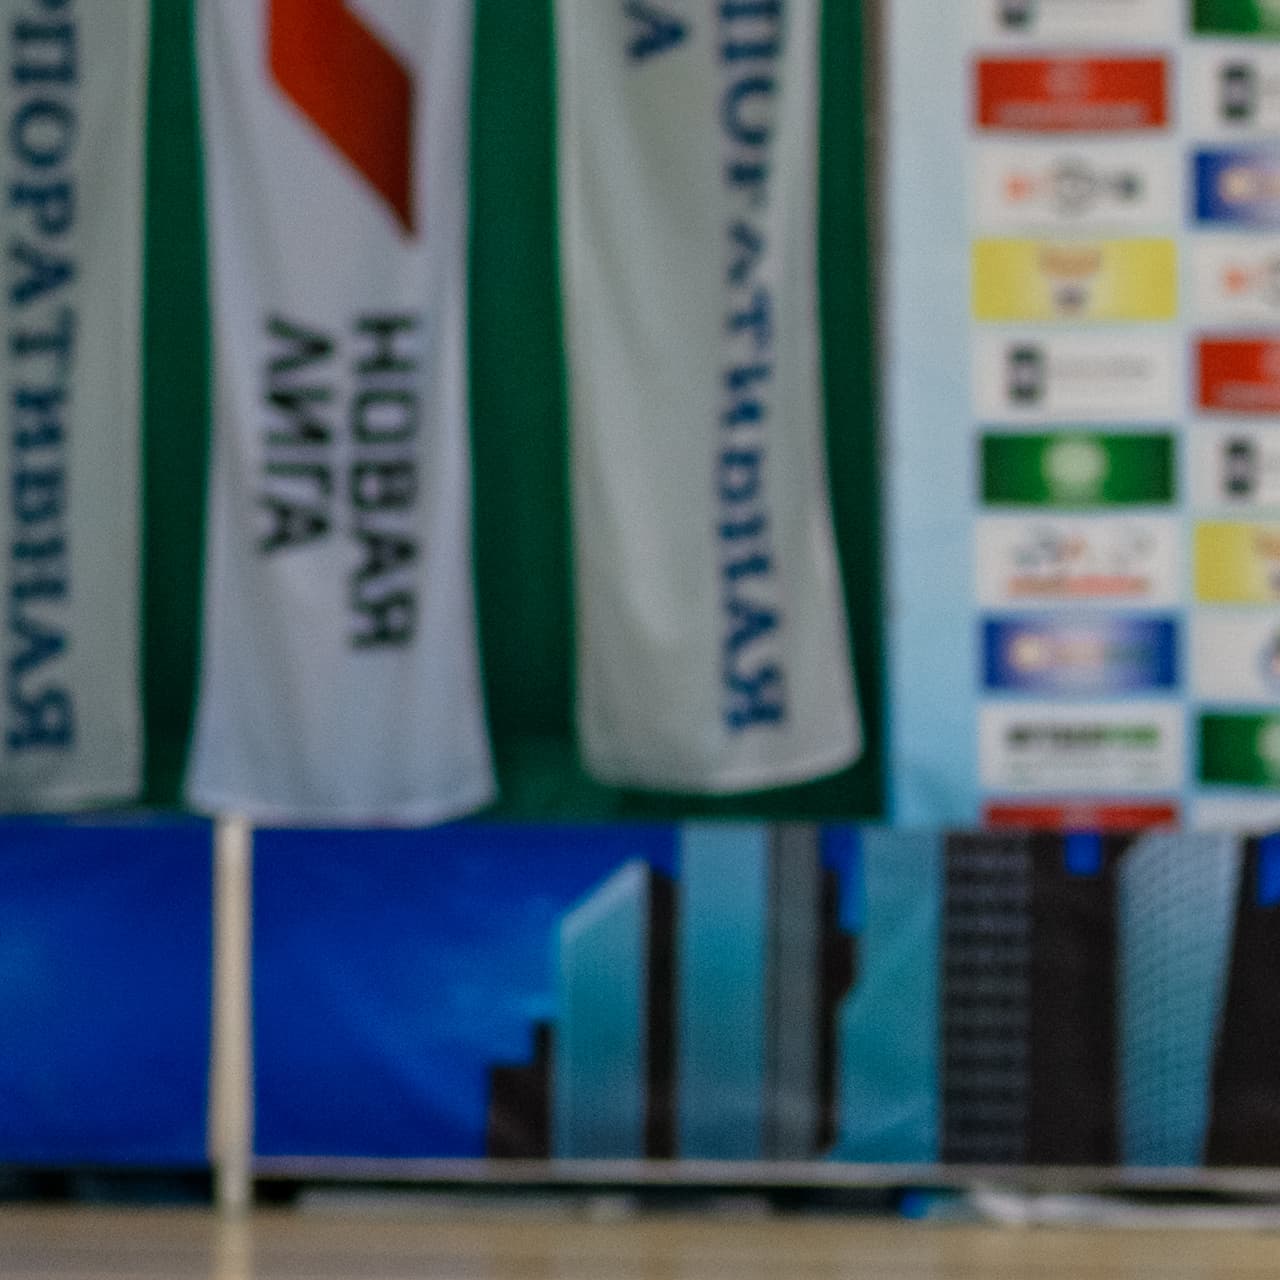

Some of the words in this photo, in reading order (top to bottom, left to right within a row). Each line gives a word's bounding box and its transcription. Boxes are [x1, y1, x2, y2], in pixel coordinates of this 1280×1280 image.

[10, 0, 79, 752] ПОРАТИВНАЯ
[257, 316, 334, 555] ЛИГА
[348, 312, 420, 651] НОВАЯ
